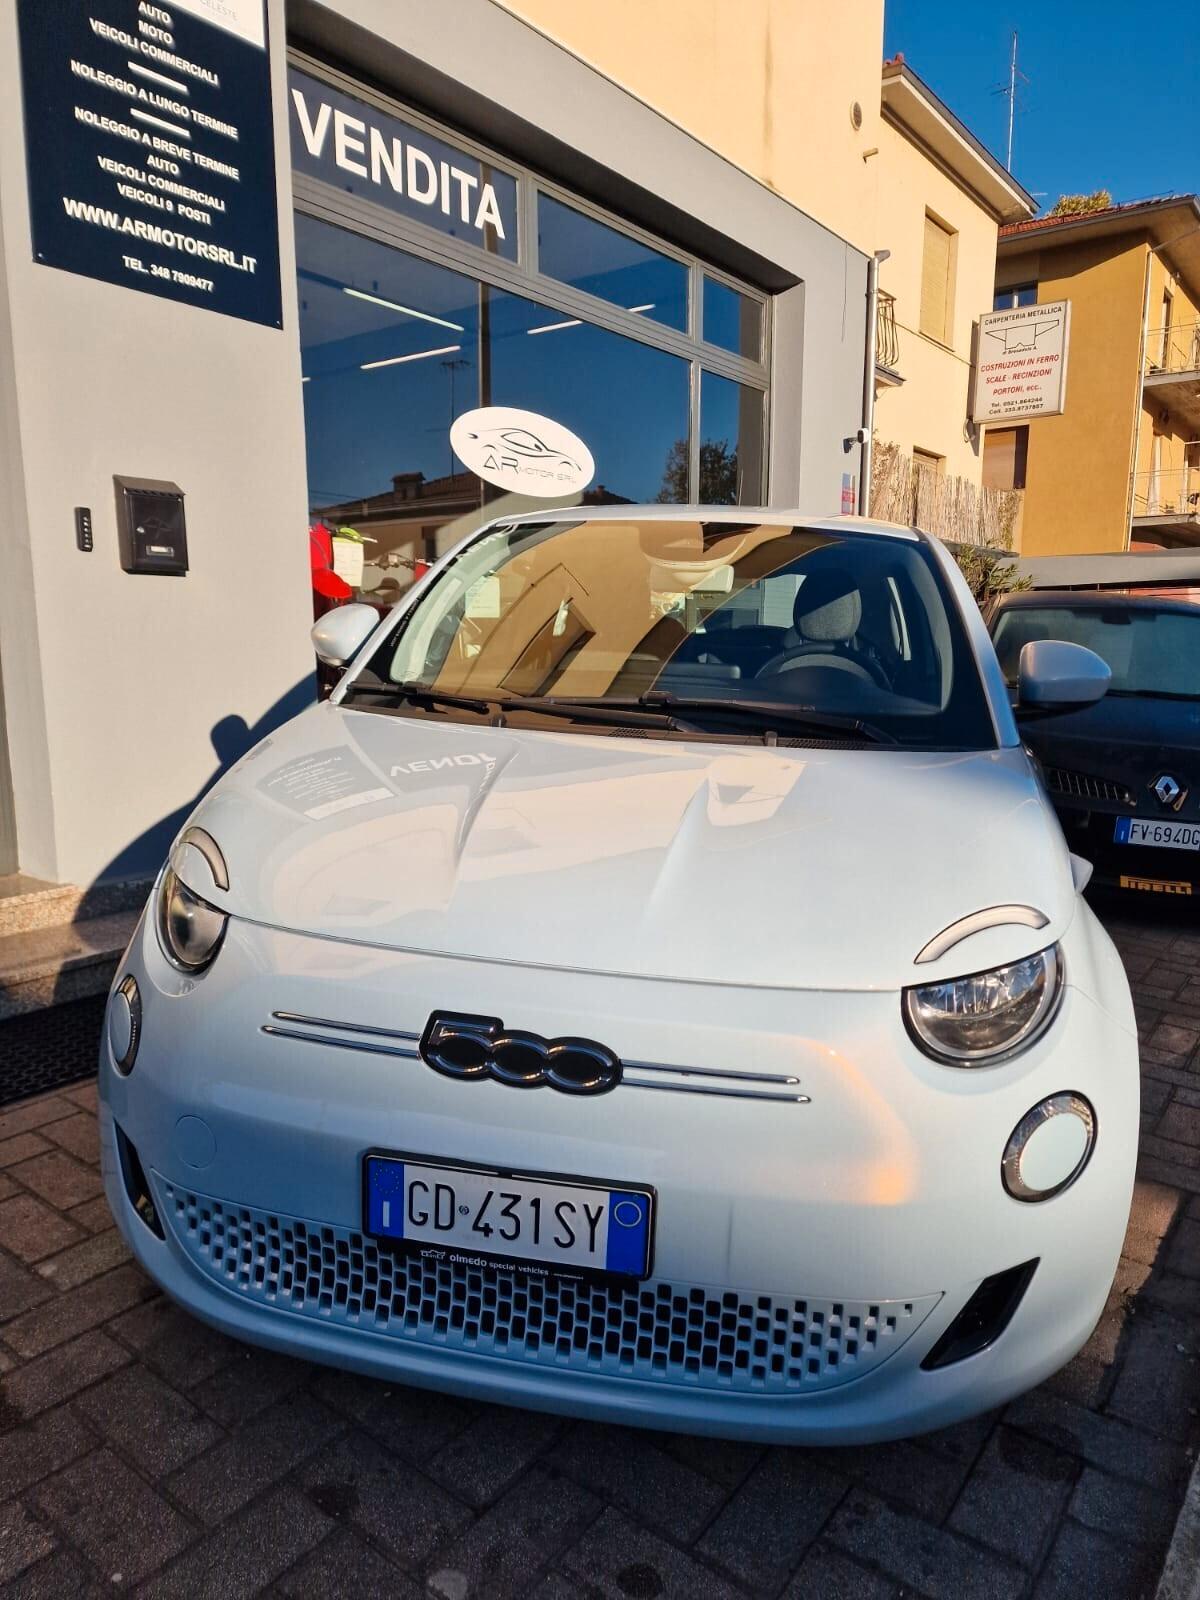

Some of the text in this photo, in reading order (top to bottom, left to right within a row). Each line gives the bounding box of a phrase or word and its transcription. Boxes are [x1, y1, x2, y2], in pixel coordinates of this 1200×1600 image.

[138, 0, 172, 25] AUTO
[138, 20, 174, 45] MOTO
[89, 17, 220, 86] VEICOLI COMMERCIALI
[70, 59, 239, 140] NOLEGGIO A LUNGO TERMINE
[74, 106, 240, 181] NOLEGGIO A BREVE TERMINE
[147, 154, 180, 176] AUTO
[291, 88, 506, 240] VENDITA
[97, 155, 226, 212] VEICOLI COMMERCIALI
[117, 182, 212, 225] VEICOLI 9 POSTI
[62, 197, 257, 274] WWW.ARMOTORSRL.IT
[122, 255, 215, 293] TEL. 348 7909477
[984, 306, 1062, 326] CARPENTERIA METALLICA
[980, 354, 1060, 372] COSTRUZIONI IN FERRO
[985, 374, 1007, 385] SCALE
[1012, 368, 1052, 380] RECINZIONI
[483, 455, 519, 475] AR
[1120, 875, 1192, 896] PIRELLI
[419, 1009, 624, 1096] 500
[449, 1254, 487, 1267] olmedo
[489, 1262, 516, 1272] special
[518, 1265, 549, 1276] vehicles
